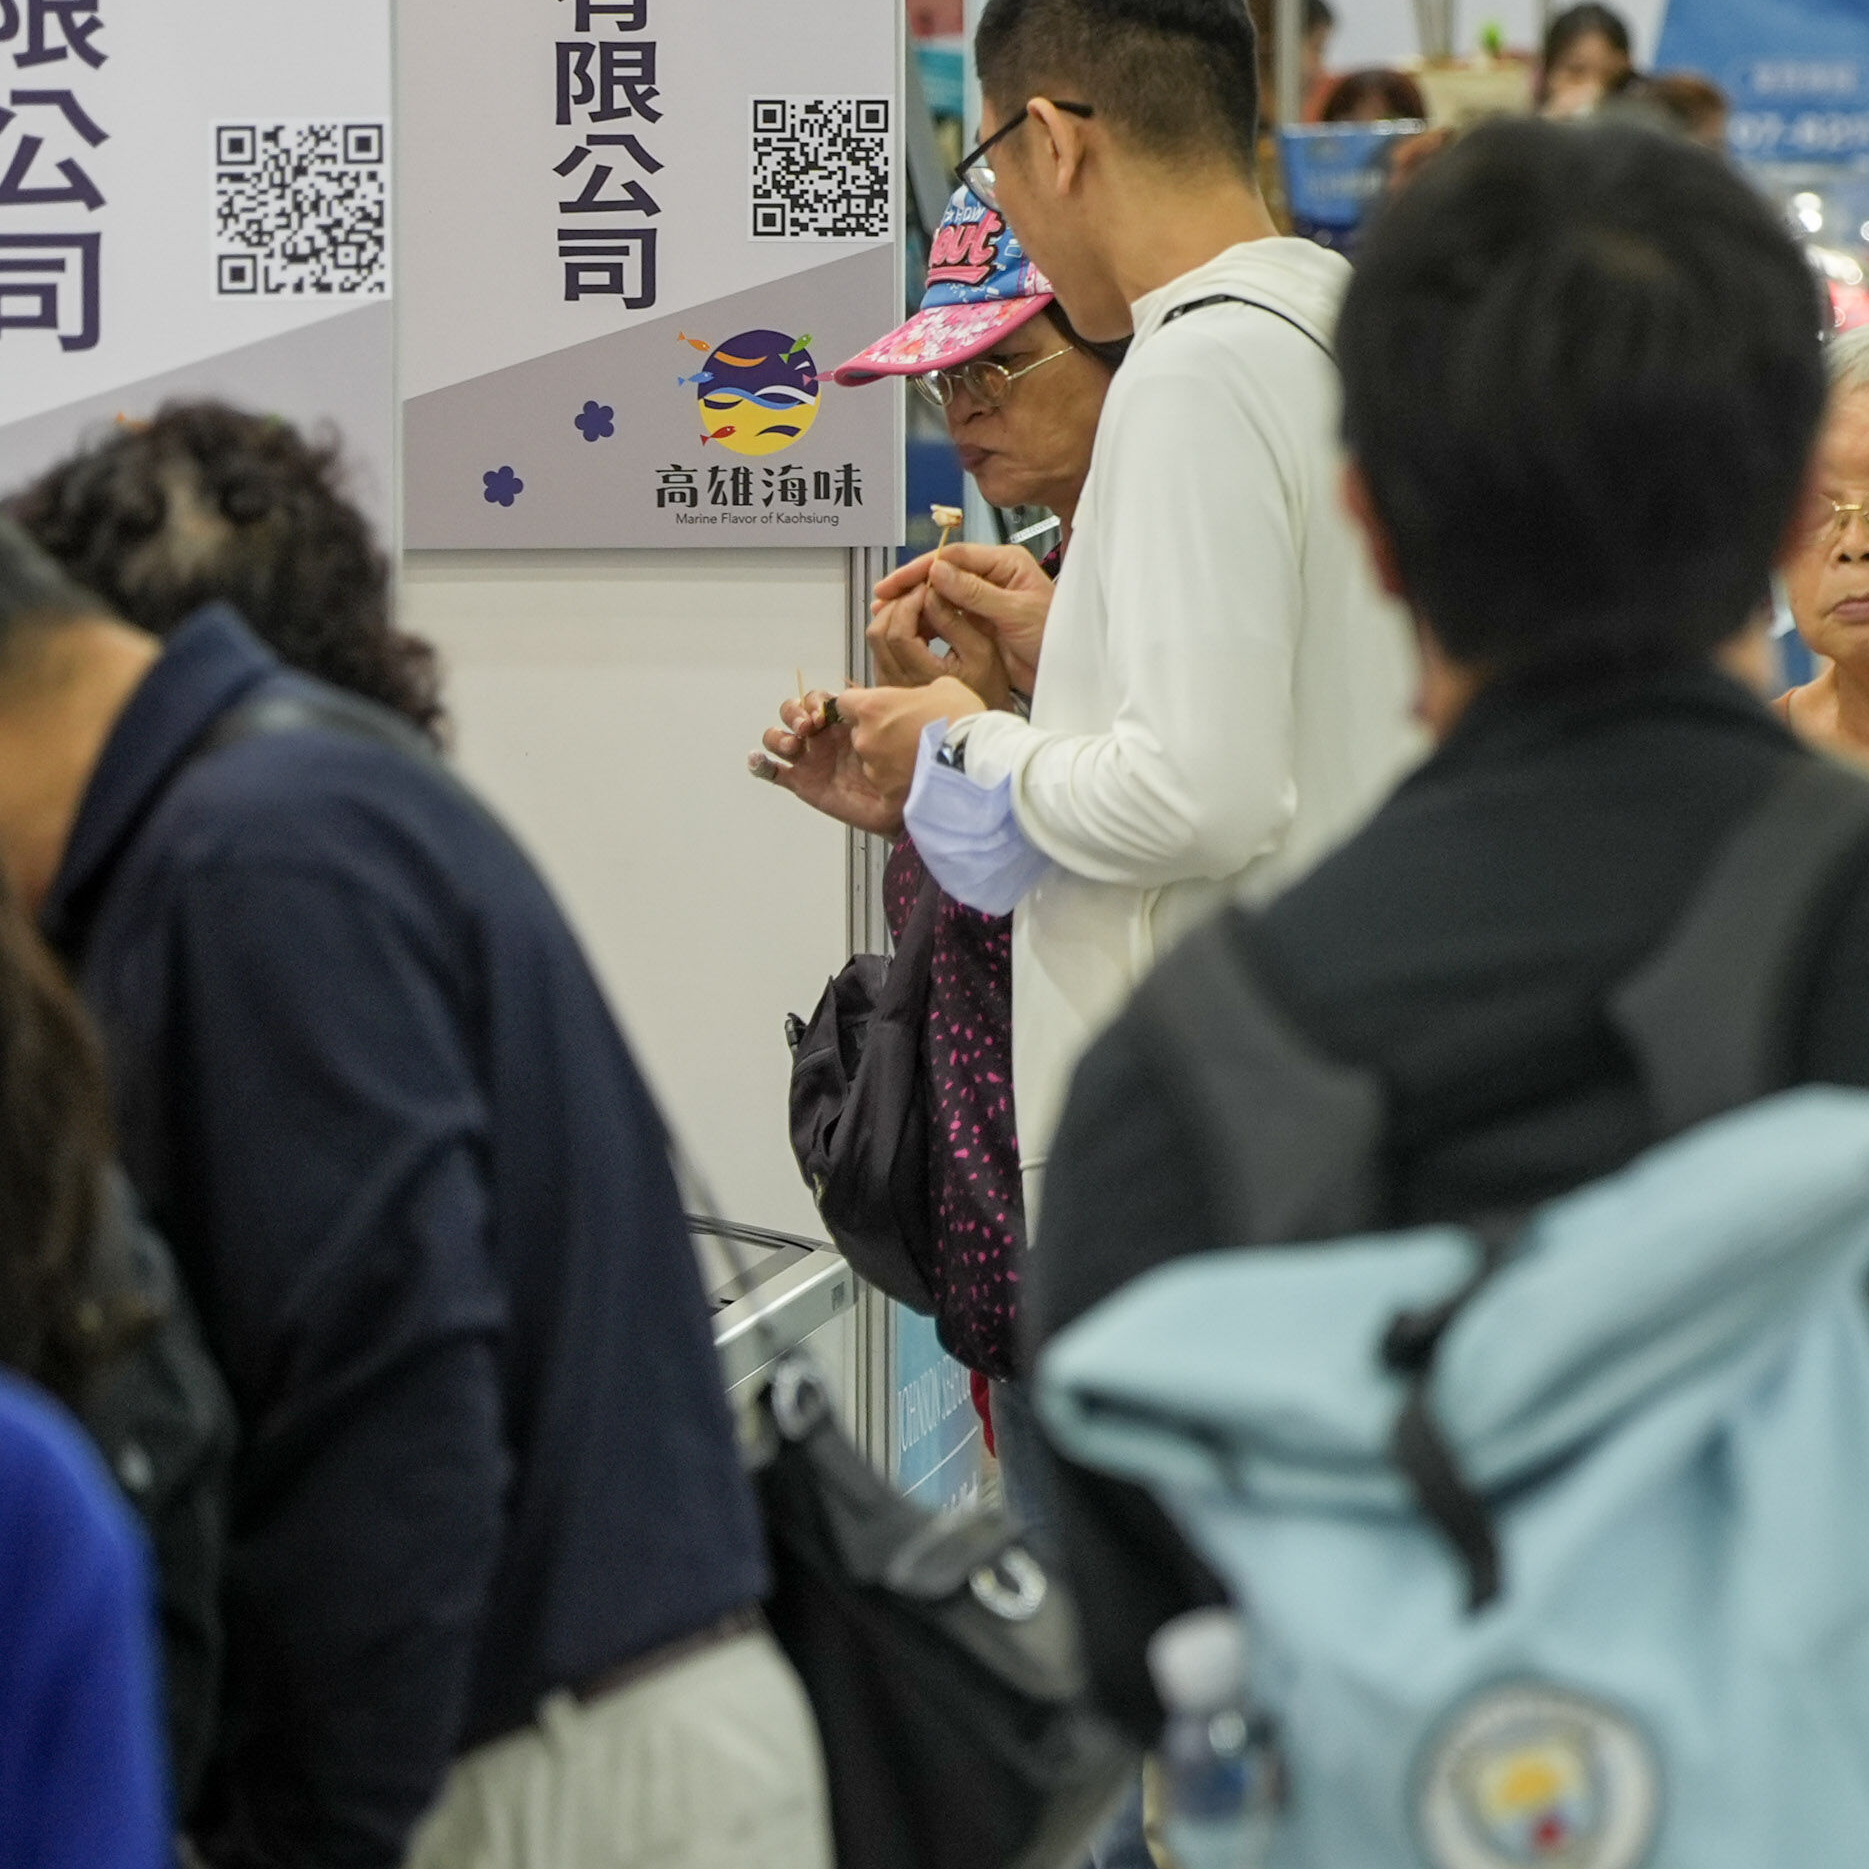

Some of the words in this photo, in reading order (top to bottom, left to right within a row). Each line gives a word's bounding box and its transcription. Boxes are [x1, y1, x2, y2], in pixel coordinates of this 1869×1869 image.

[655, 463, 863, 508] 高雄海味
[676, 513, 717, 524] Marine
[721, 513, 757, 524] Flavor
[760, 512, 774, 524] of
[776, 512, 839, 526] Kaohsiung
